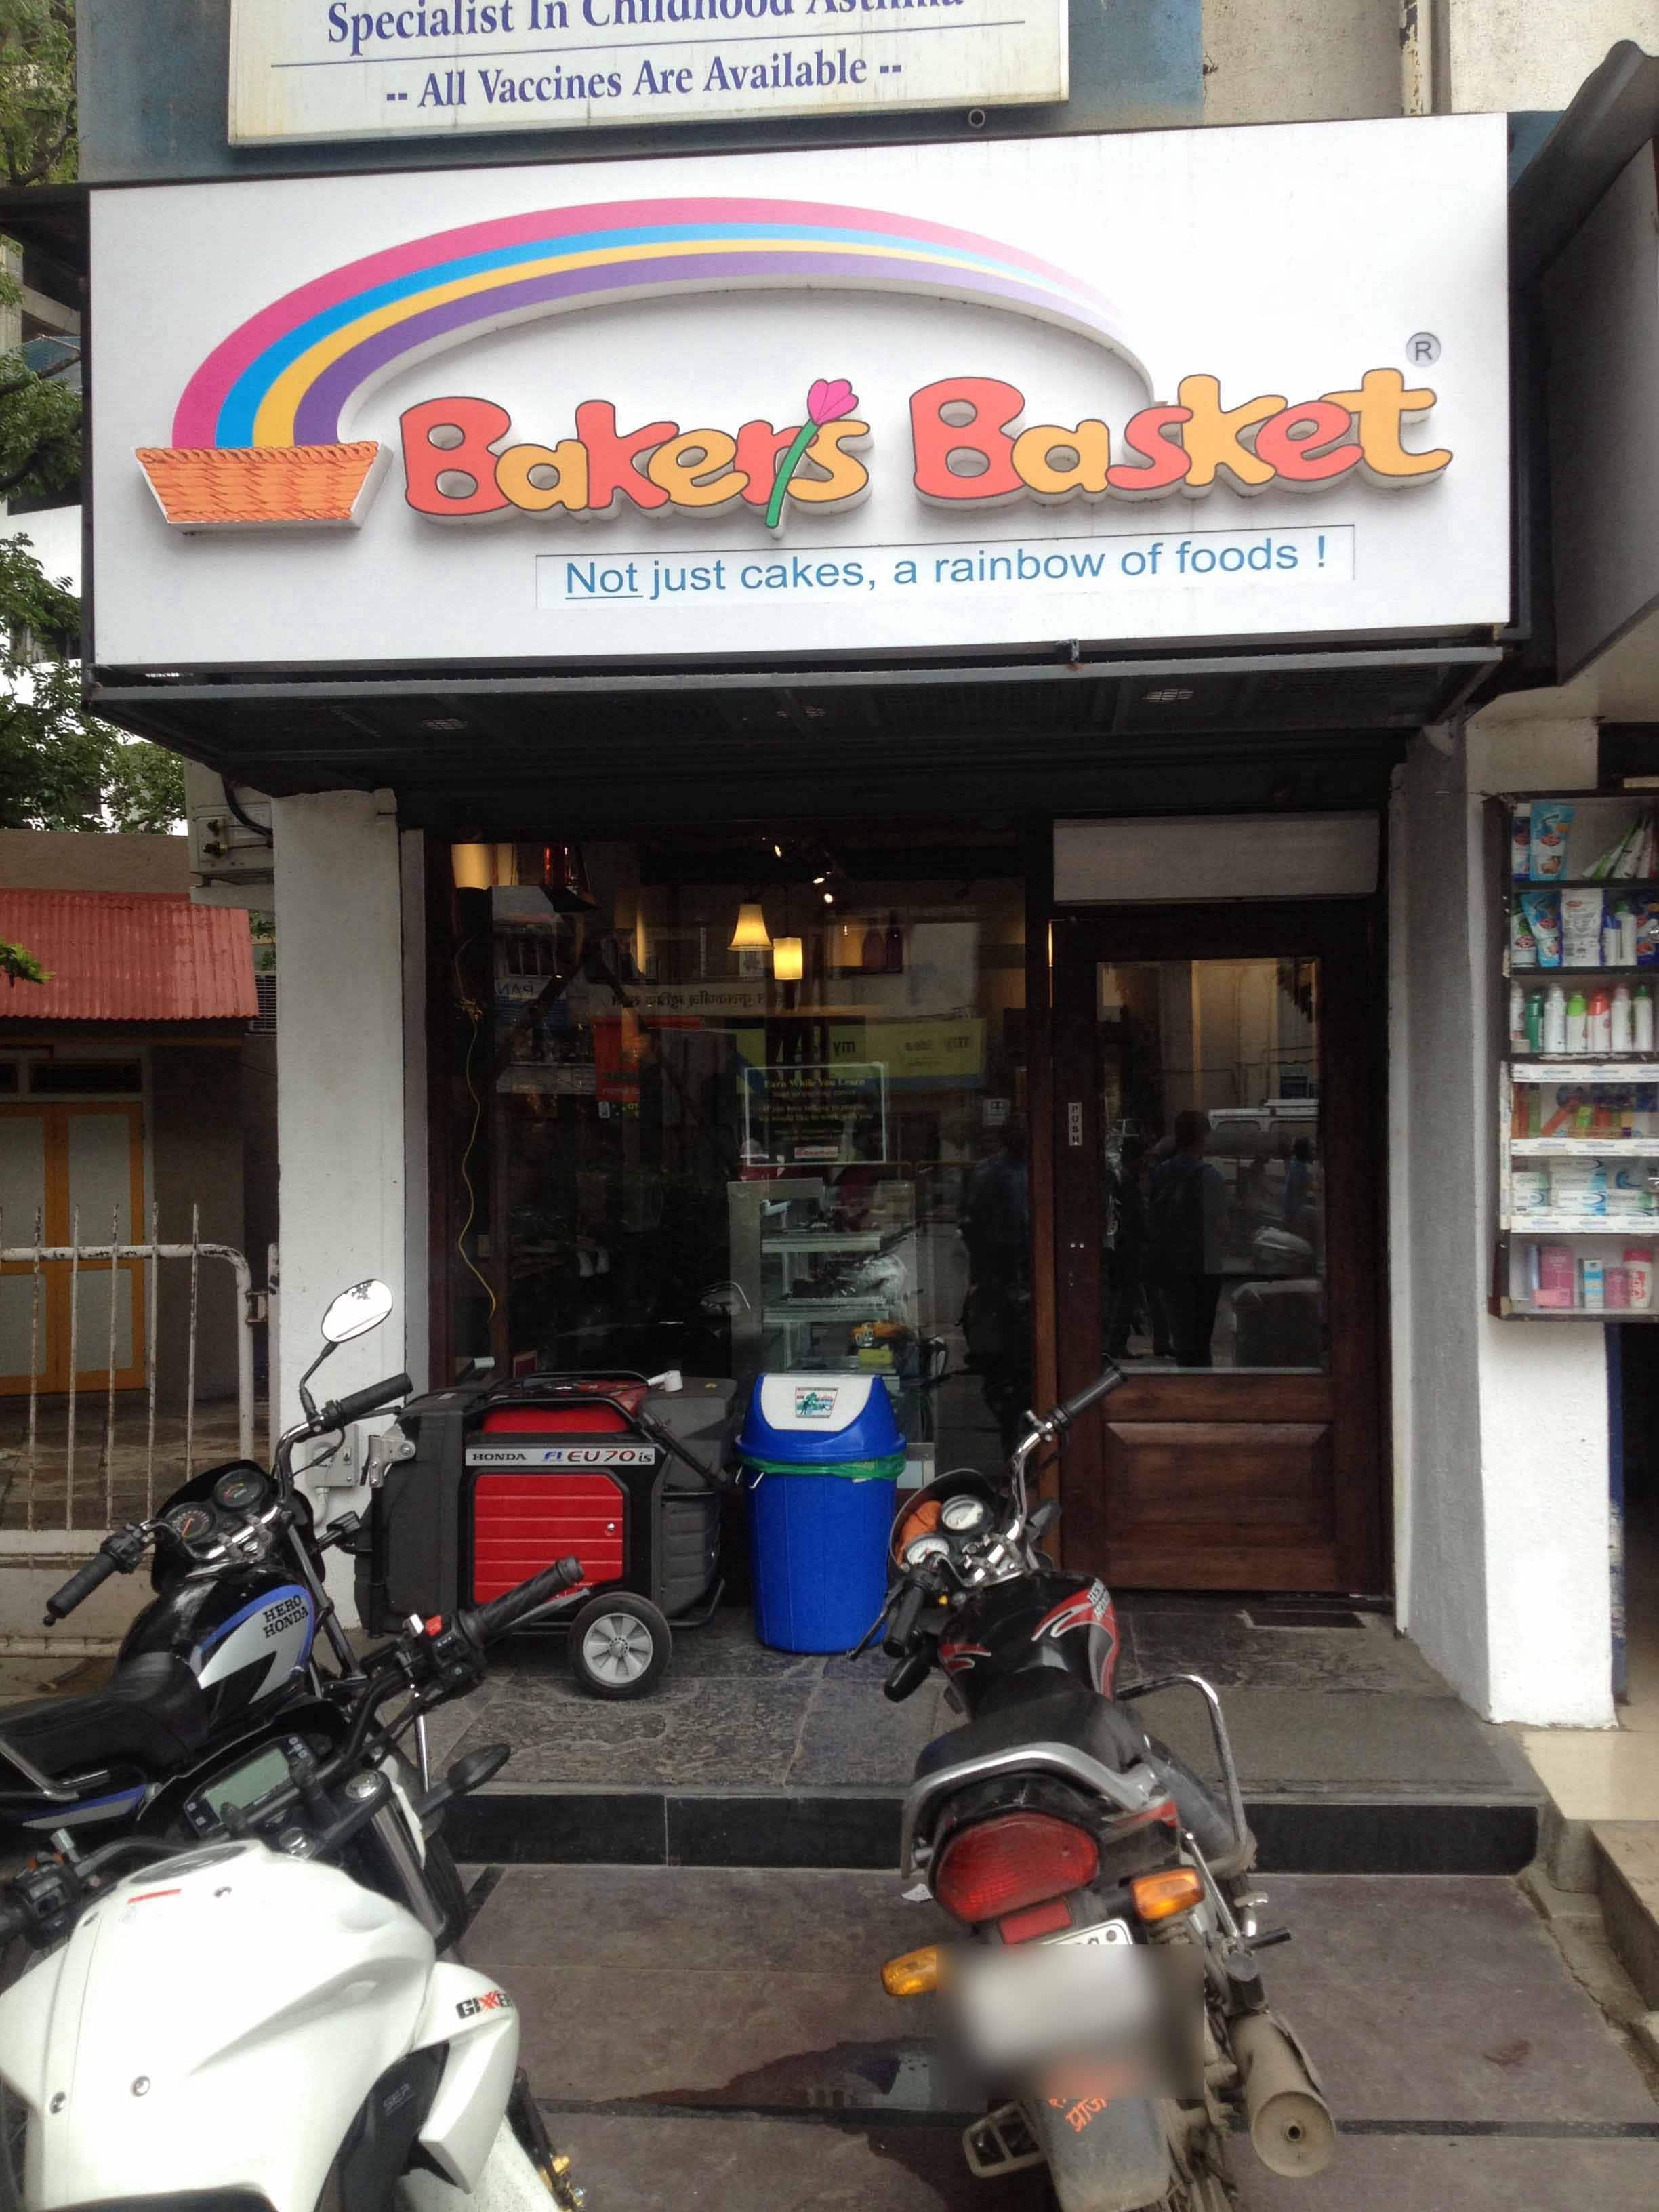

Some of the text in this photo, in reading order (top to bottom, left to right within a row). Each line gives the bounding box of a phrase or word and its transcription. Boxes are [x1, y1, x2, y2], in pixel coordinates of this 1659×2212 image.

[328, 0, 515, 56] Specialist
[527, 0, 569, 29] In
[417, 70, 467, 107] All
[478, 64, 623, 104] Vaccines
[632, 60, 693, 96] Are
[702, 48, 867, 91] Available
[909, 367, 1452, 500] Basket
[566, 562, 638, 594] Not
[649, 560, 726, 600] just
[740, 556, 876, 591] cakes,
[893, 559, 918, 585] a
[935, 548, 1105, 583] rainbow
[1120, 542, 1162, 575] of
[1176, 537, 1299, 573] foods
[789, 1078, 816, 1088] While
[819, 1078, 836, 1087] You
[472, 1453, 527, 1461] HONDA
[262, 1595, 302, 1623] HERO
[263, 1605, 310, 1639] HONDA
